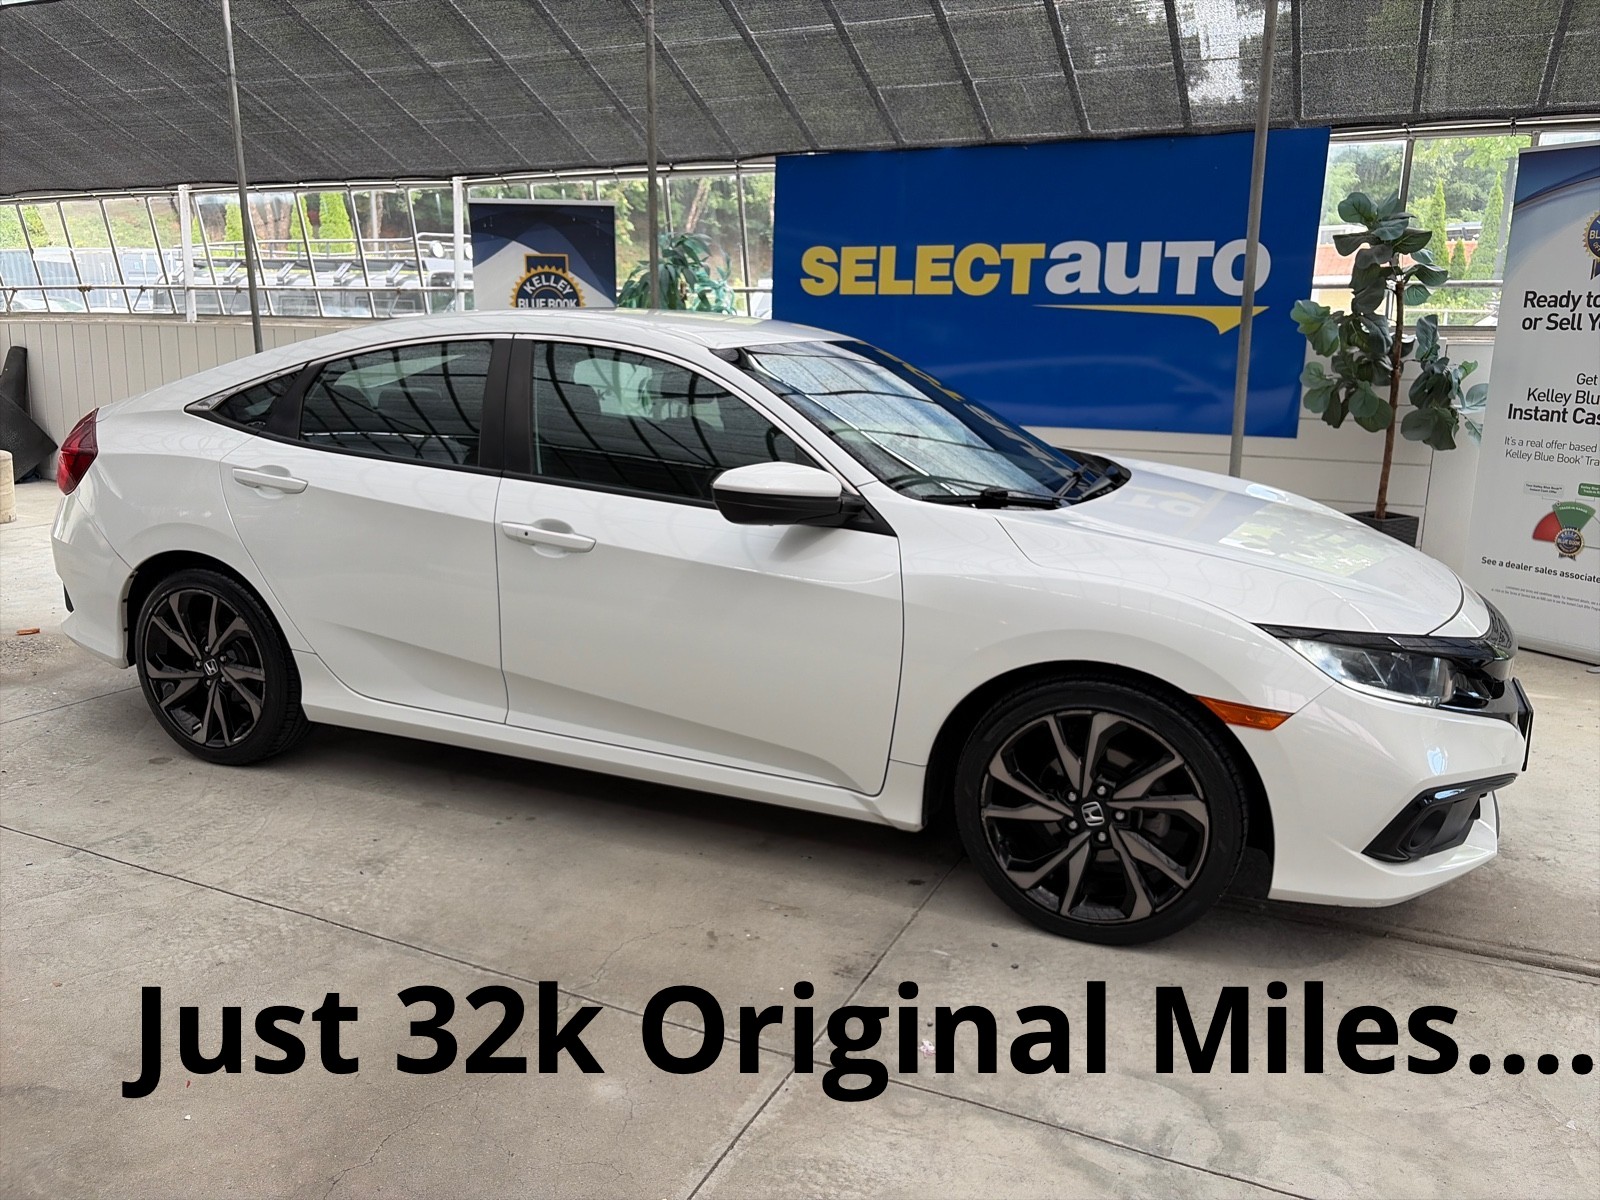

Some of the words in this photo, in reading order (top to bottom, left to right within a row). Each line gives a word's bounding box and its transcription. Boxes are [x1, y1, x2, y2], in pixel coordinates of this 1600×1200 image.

[523, 274, 574, 294] KELLEY
[1523, 290, 1583, 312] Ready
[1522, 317, 1543, 331] or
[1545, 312, 1583, 331] Sell
[1588, 312, 1600, 331] Y
[1576, 372, 1598, 386] Get
[1526, 387, 1572, 406] Kelley
[1507, 403, 1568, 423] Instant
[1504, 436, 1517, 446] It's
[1518, 438, 1524, 446] a
[1526, 440, 1543, 448] real
[1545, 440, 1567, 450] offer
[1569, 441, 1597, 452] based
[1505, 449, 1532, 462] Kelley
[1534, 451, 1554, 462] Blue
[1481, 556, 1497, 566] See
[1505, 560, 1533, 572] dealer
[1534, 566, 1558, 576] sales
[1559, 570, 1600, 584] associate
